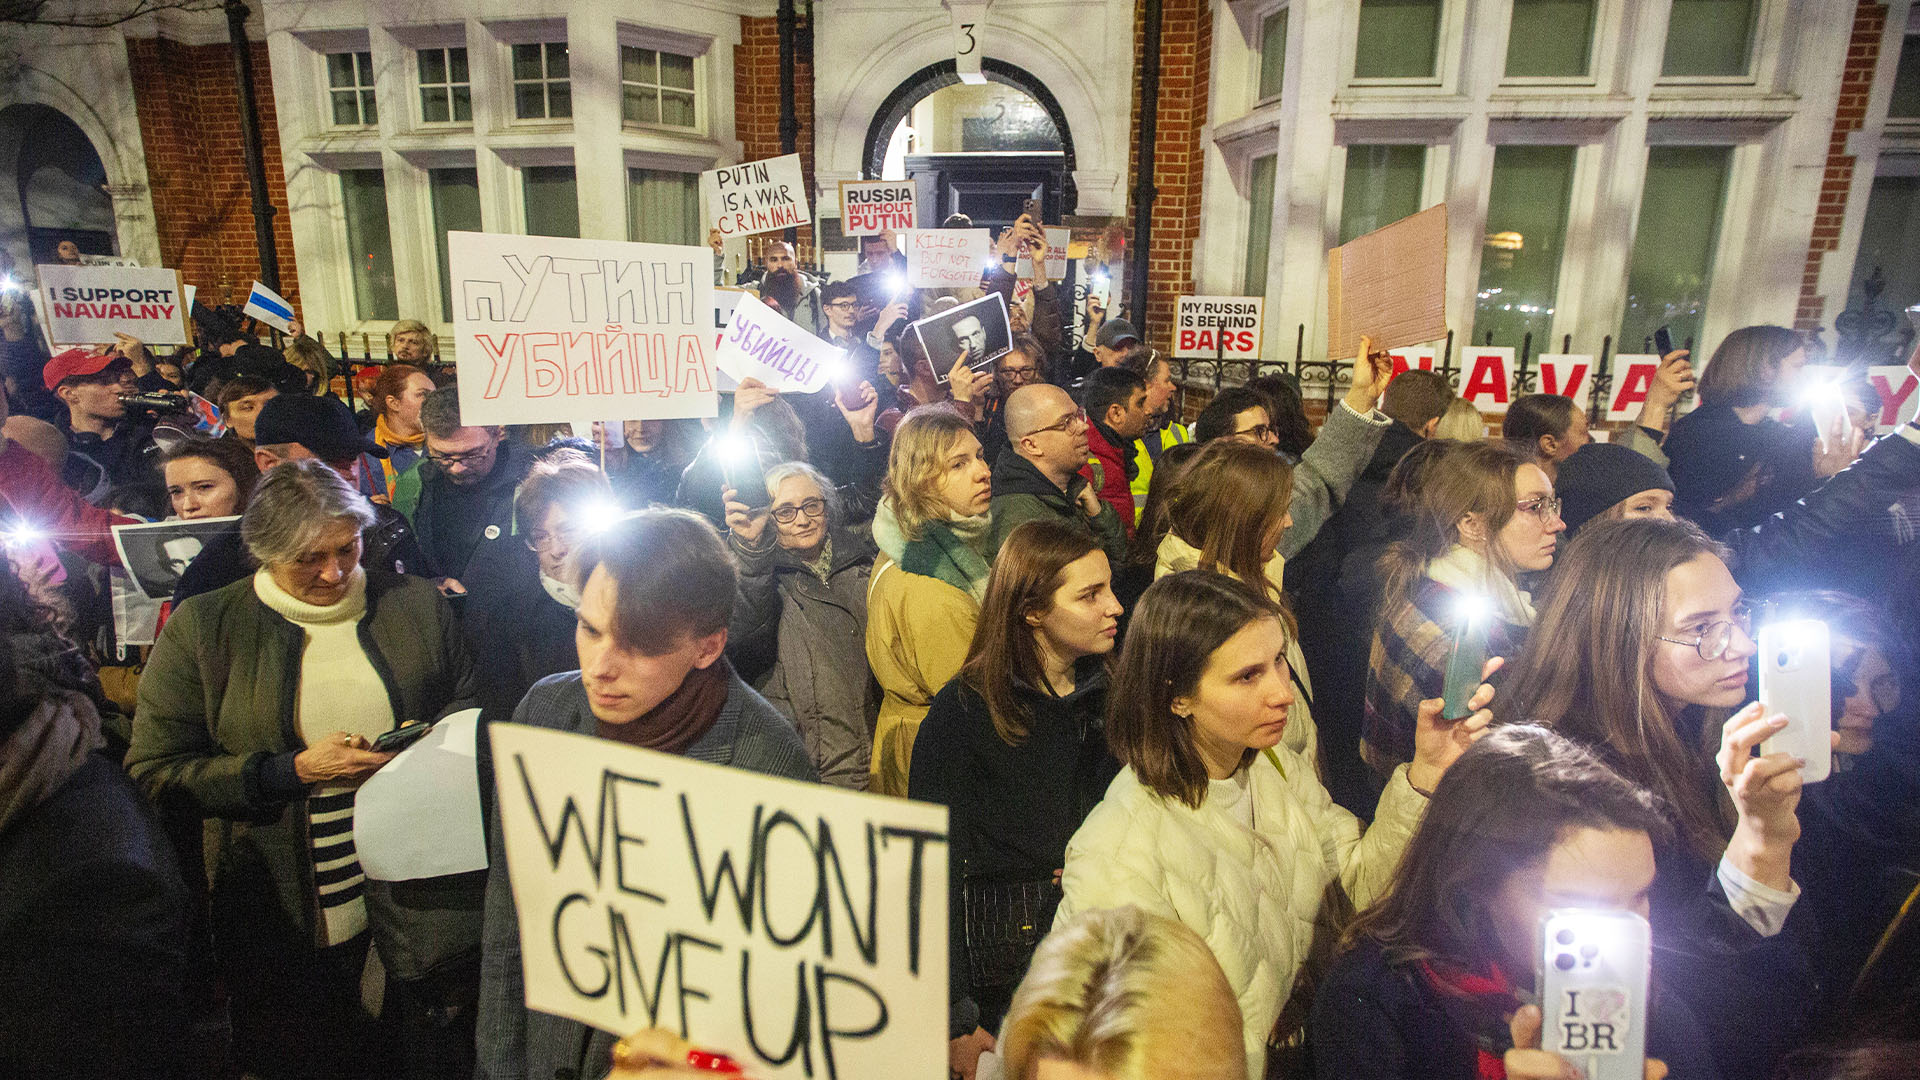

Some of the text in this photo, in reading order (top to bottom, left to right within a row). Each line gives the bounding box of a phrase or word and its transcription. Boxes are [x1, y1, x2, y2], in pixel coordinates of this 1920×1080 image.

[958, 24, 976, 55] 3
[717, 162, 770, 189] PUTIN
[722, 185, 794, 213] IS A WAR
[847, 188, 912, 203] RUSSIA
[718, 203, 808, 234] CRIMINAL
[848, 202, 912, 214] WITHOUT
[849, 213, 912, 230] PUTIN
[915, 233, 969, 249] KILLED
[949, 254, 971, 268] NOT
[921, 266, 980, 281] FORGOTTE
[50, 287, 172, 303] I SUPPORT
[54, 303, 175, 320] NAVALNY
[1181, 302, 1257, 315] MY RUSSIA
[1181, 315, 1256, 328] IS BEHIND
[730, 314, 819, 386] УБИЙЦЫ
[1180, 330, 1254, 352] BARS
[474, 325, 712, 399] УБИЙЦА
[514, 753, 667, 905] WE
[552, 893, 890, 1080] GIVE UP
[1565, 991, 1580, 1017] I
[1562, 1022, 1618, 1050] BR
